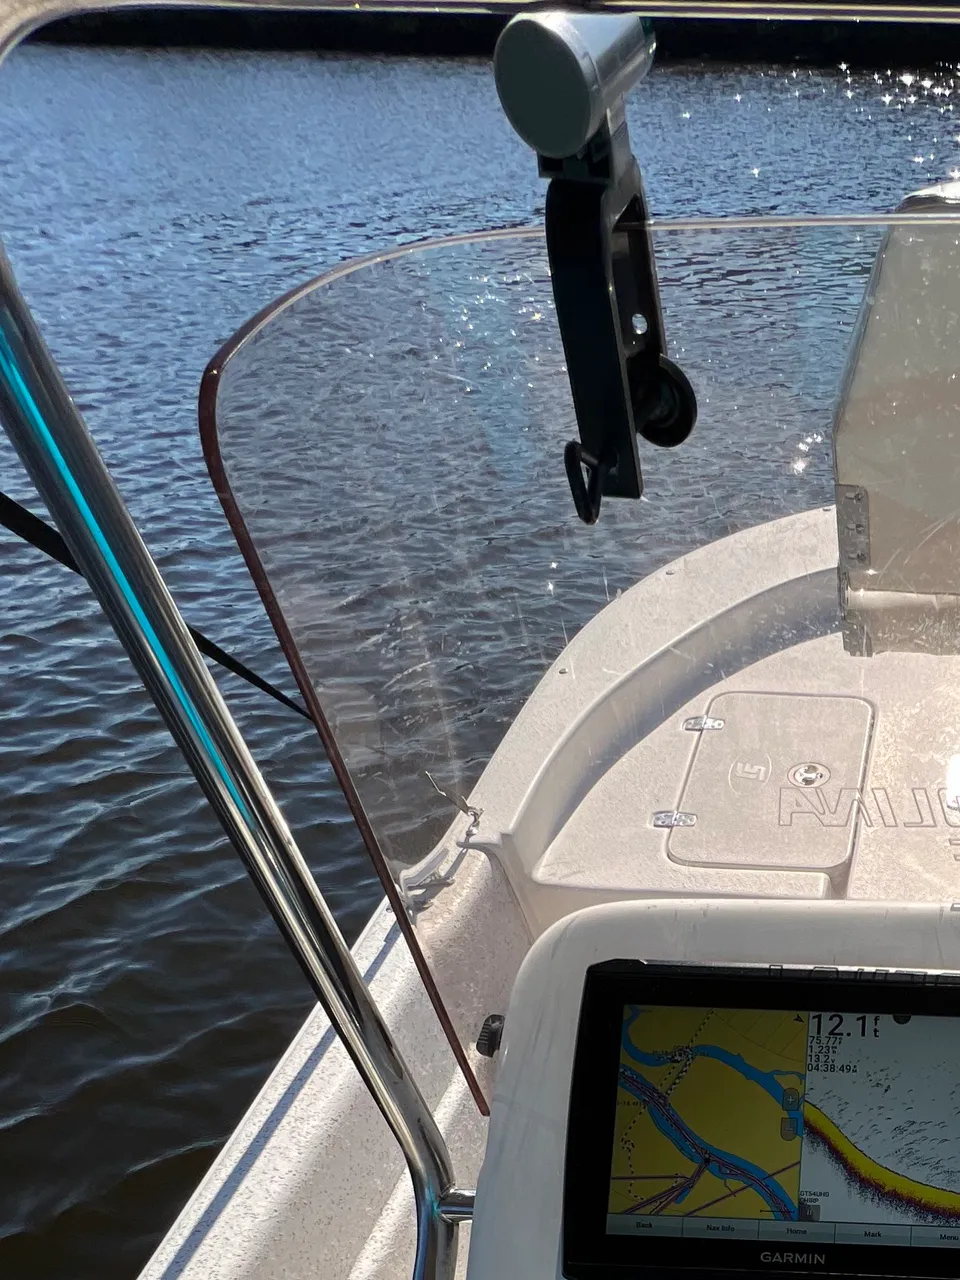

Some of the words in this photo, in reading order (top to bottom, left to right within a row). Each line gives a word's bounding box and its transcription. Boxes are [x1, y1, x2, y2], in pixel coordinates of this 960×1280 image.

[812, 1013, 867, 1037] 12.1
[808, 1054, 831, 1064] 13.2
[807, 1063, 852, 1074] 04:38:49
[721, 1224, 735, 1232] Info
[786, 1227, 808, 1235] Home
[864, 1230, 883, 1238] Mark
[939, 1233, 960, 1241] Menu
[760, 1251, 826, 1265] GARMIN
